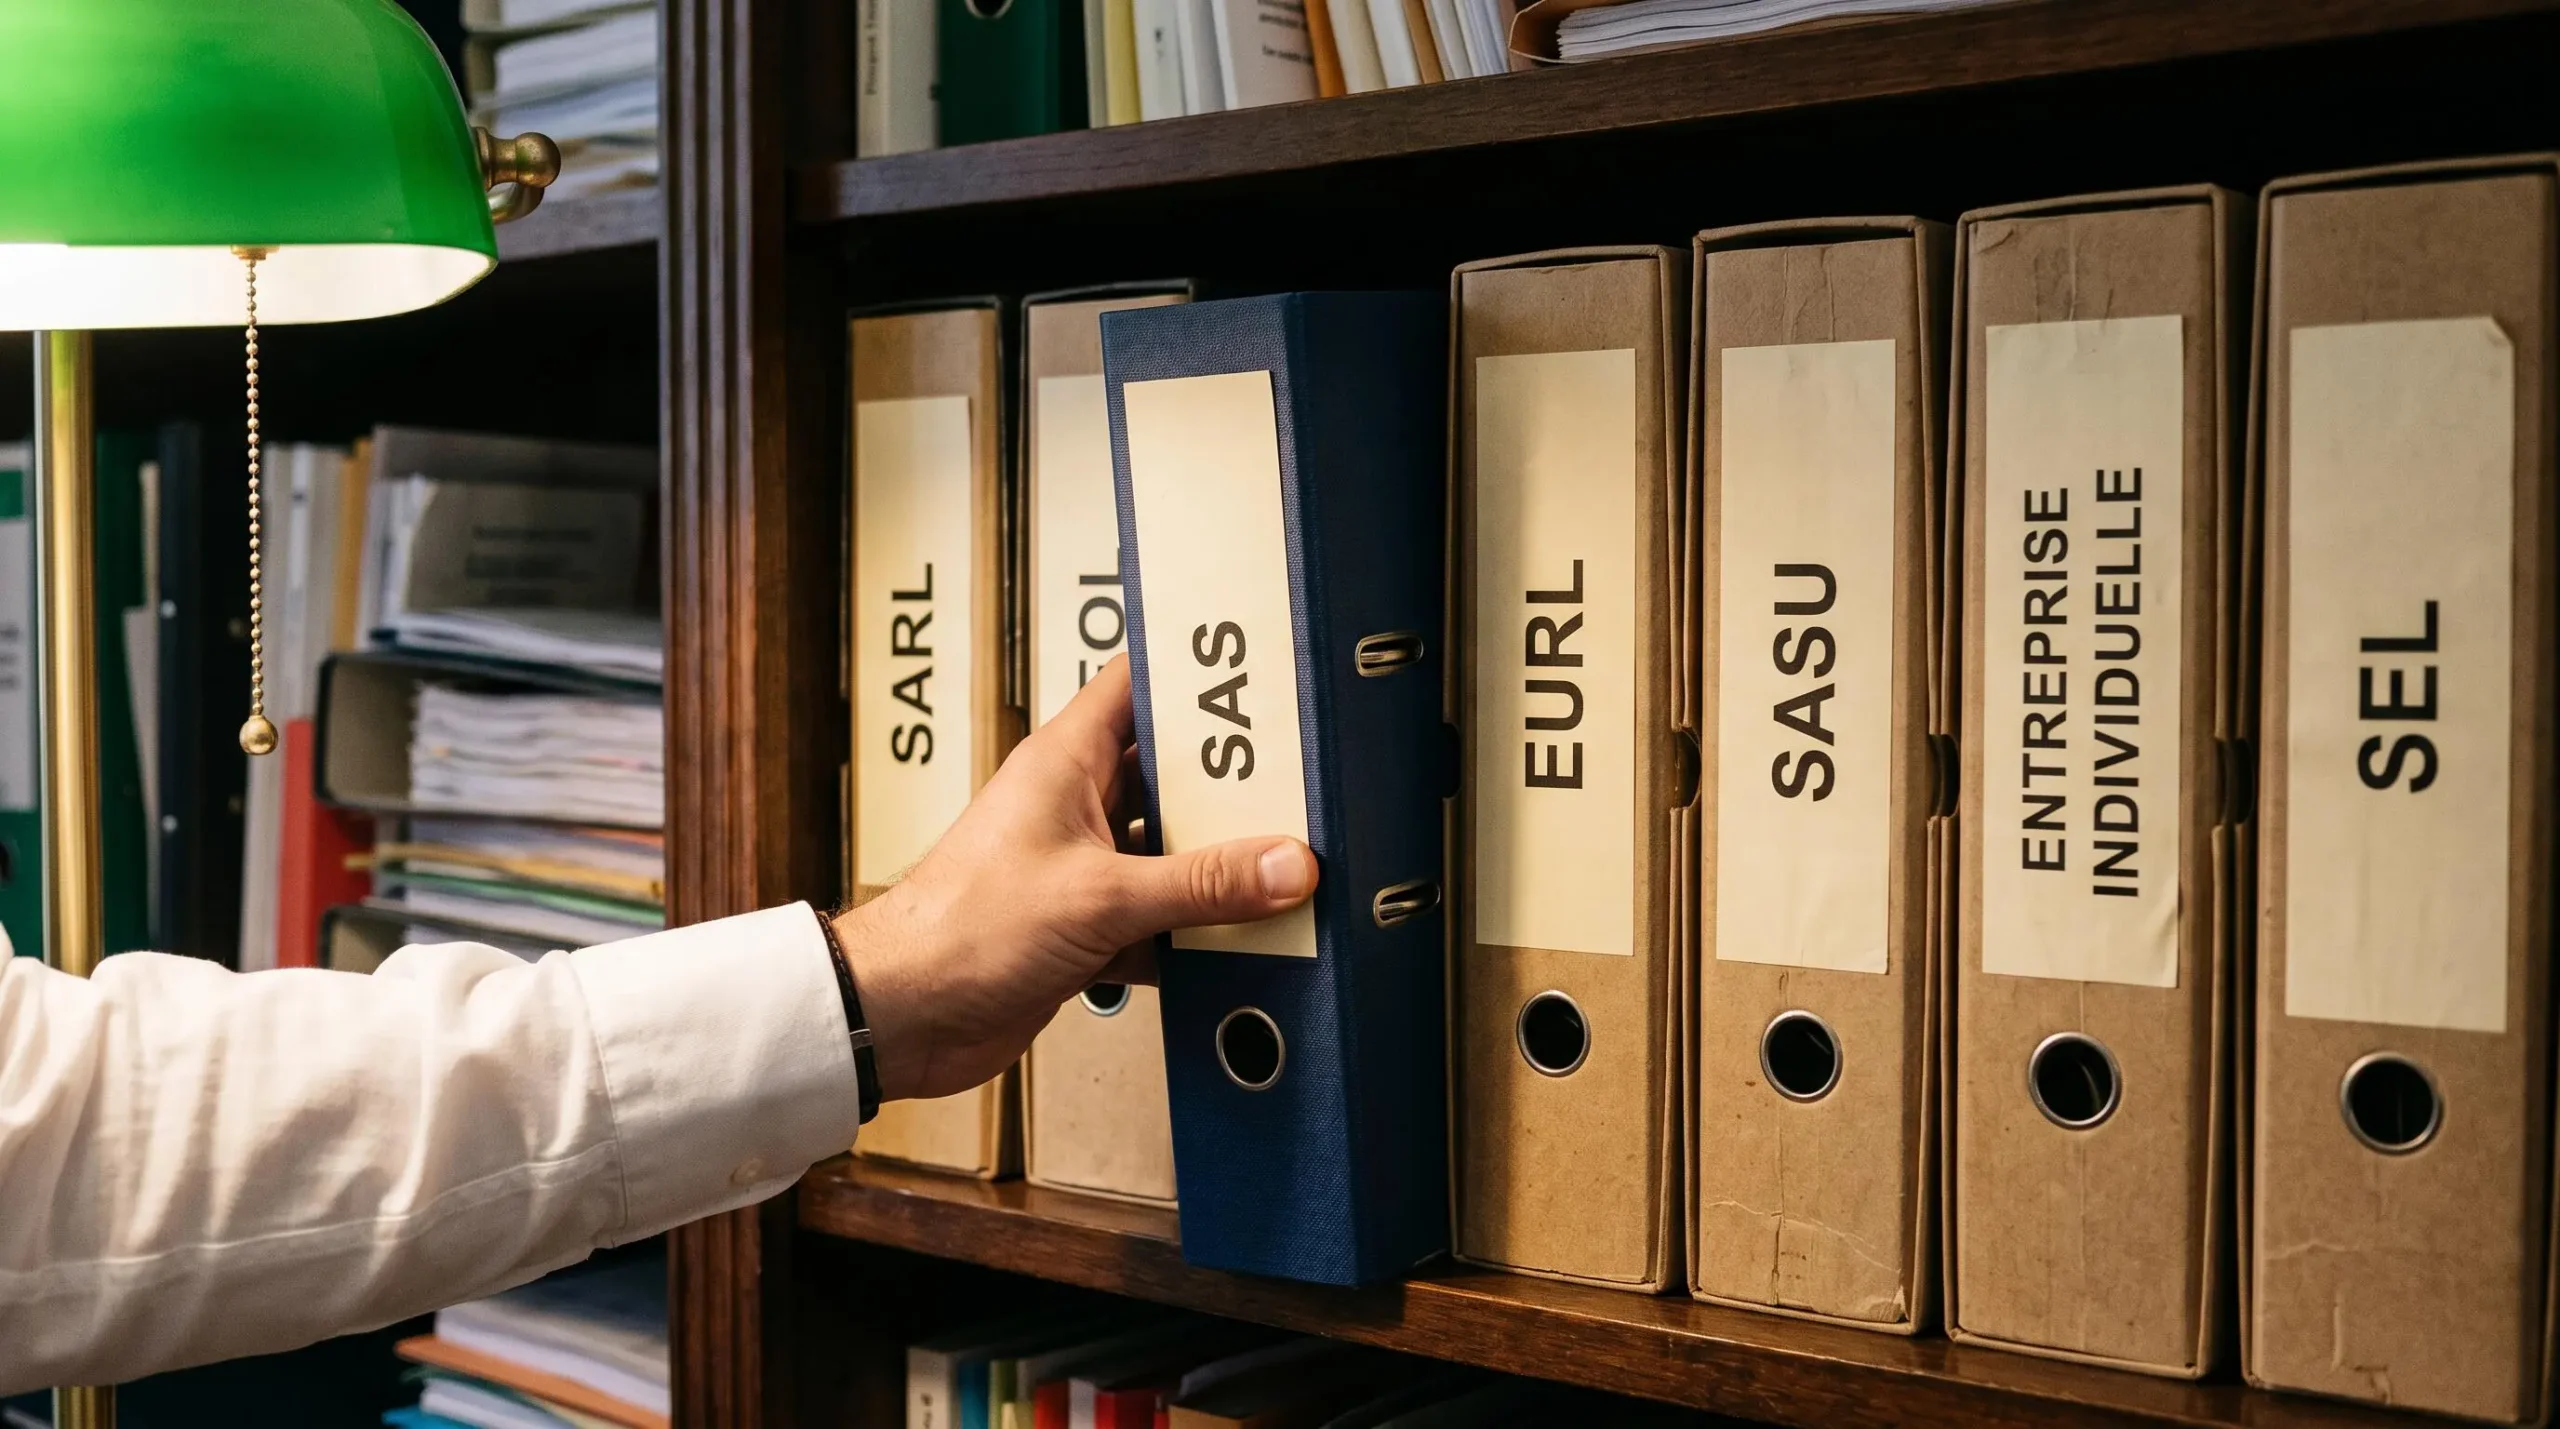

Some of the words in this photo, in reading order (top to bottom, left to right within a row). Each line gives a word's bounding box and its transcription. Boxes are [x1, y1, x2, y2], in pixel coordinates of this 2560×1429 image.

[891, 563, 934, 766] SARL
[1192, 620, 1255, 782] SAS
[1524, 559, 1584, 790] EURL
[1771, 563, 1837, 802] SASU
[2022, 487, 2069, 872] ENTREPRISE
[2092, 467, 2142, 898] INDIVIDUELLE
[2357, 600, 2439, 794] SEL
